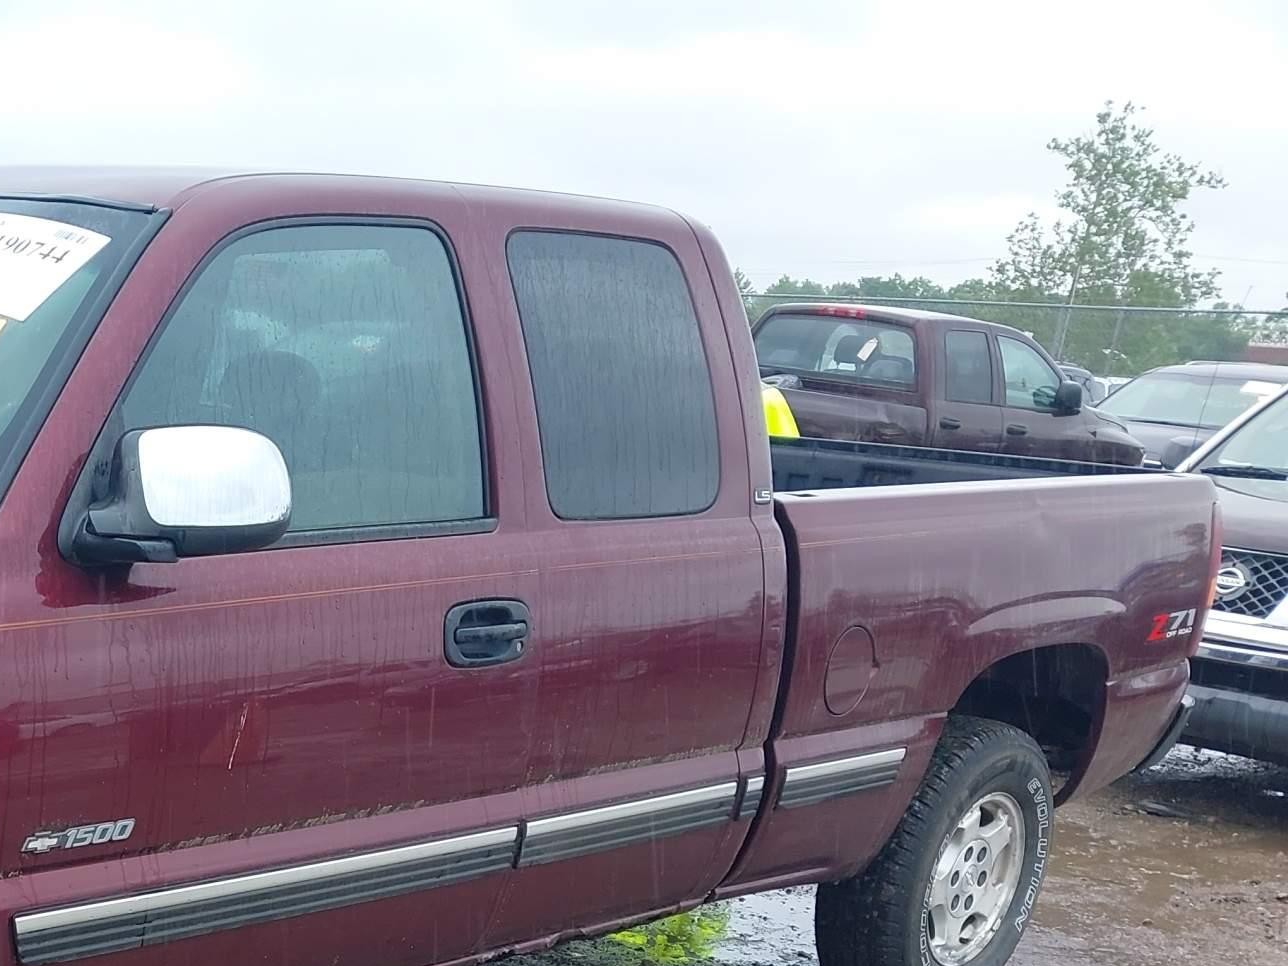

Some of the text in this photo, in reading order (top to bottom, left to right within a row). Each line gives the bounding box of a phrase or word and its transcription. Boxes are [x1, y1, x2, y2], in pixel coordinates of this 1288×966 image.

[755, 490, 771, 501] LS
[1146, 608, 1197, 642] Z71
[64, 818, 136, 849] 1500
[1015, 777, 1050, 933] EVOLUTION
